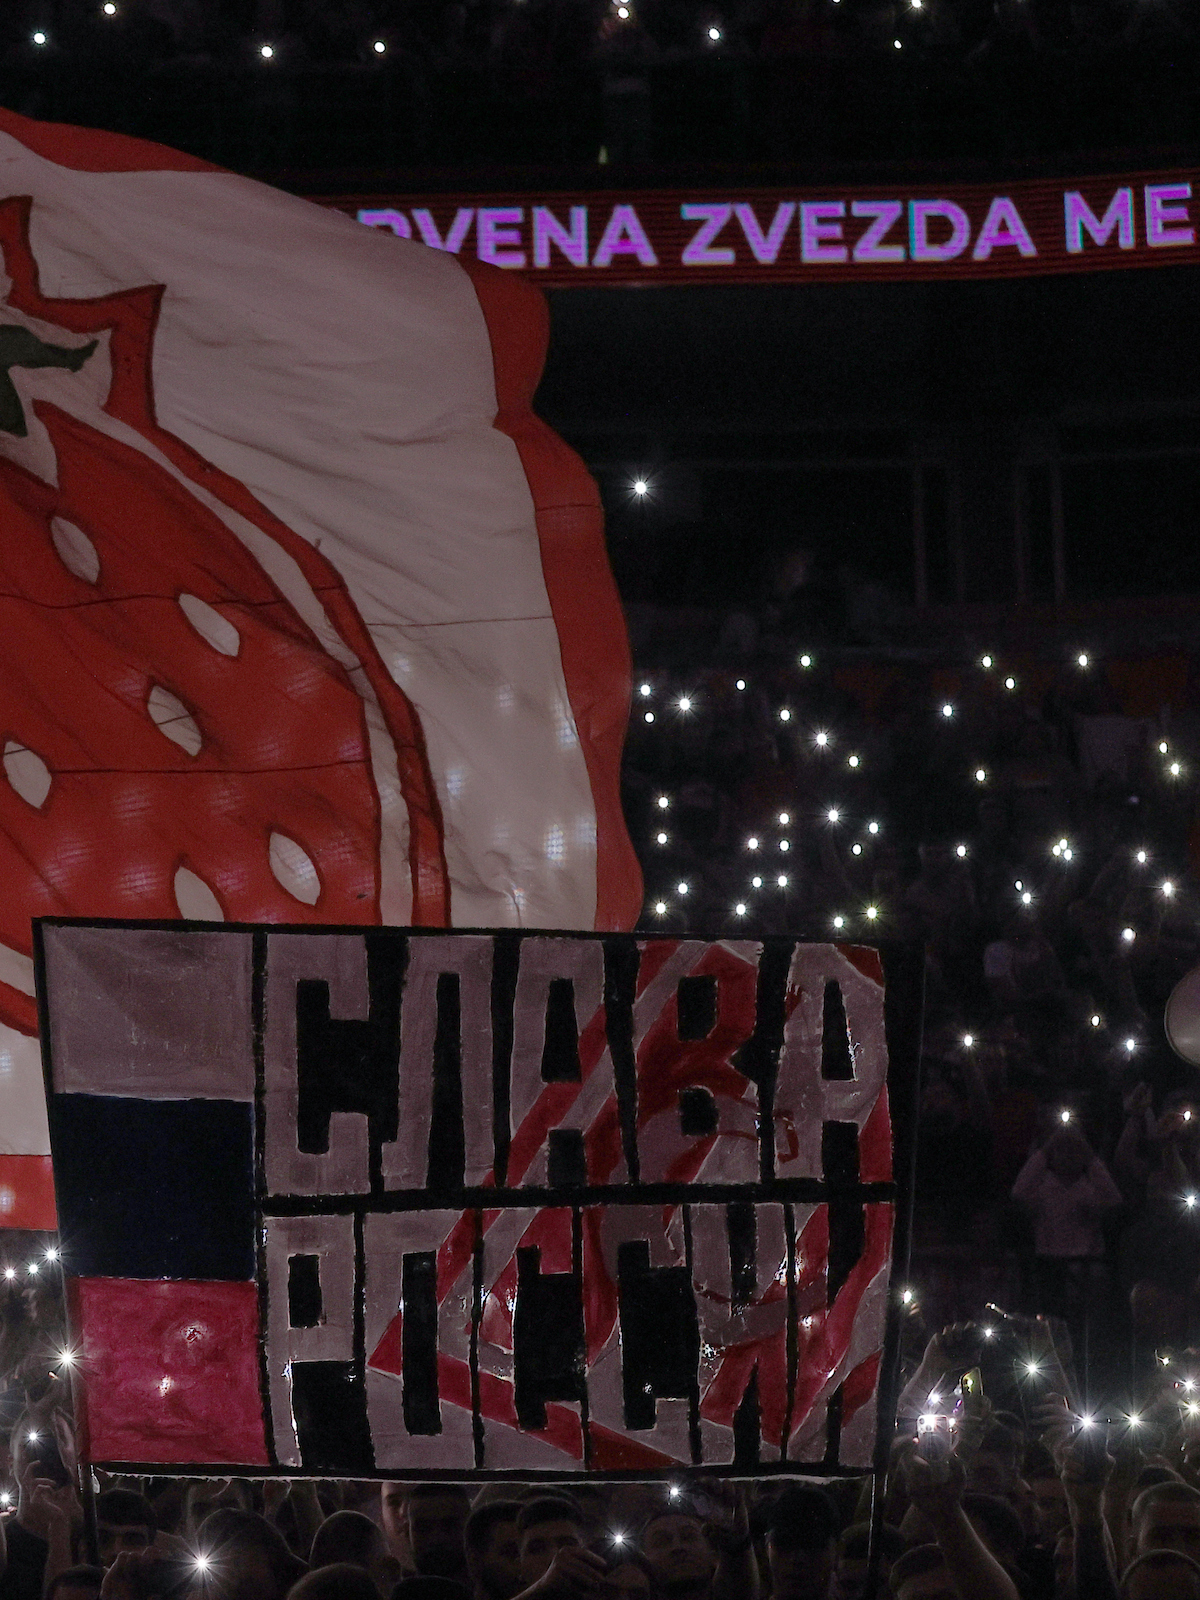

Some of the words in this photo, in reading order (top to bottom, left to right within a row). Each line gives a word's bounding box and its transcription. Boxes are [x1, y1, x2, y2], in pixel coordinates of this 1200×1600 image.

[681, 197, 1037, 265] ZVEZDA
[1063, 182, 1196, 254] ME
[264, 932, 895, 1197] СЛАВА
[266, 1202, 895, 1470] РОССИИ
